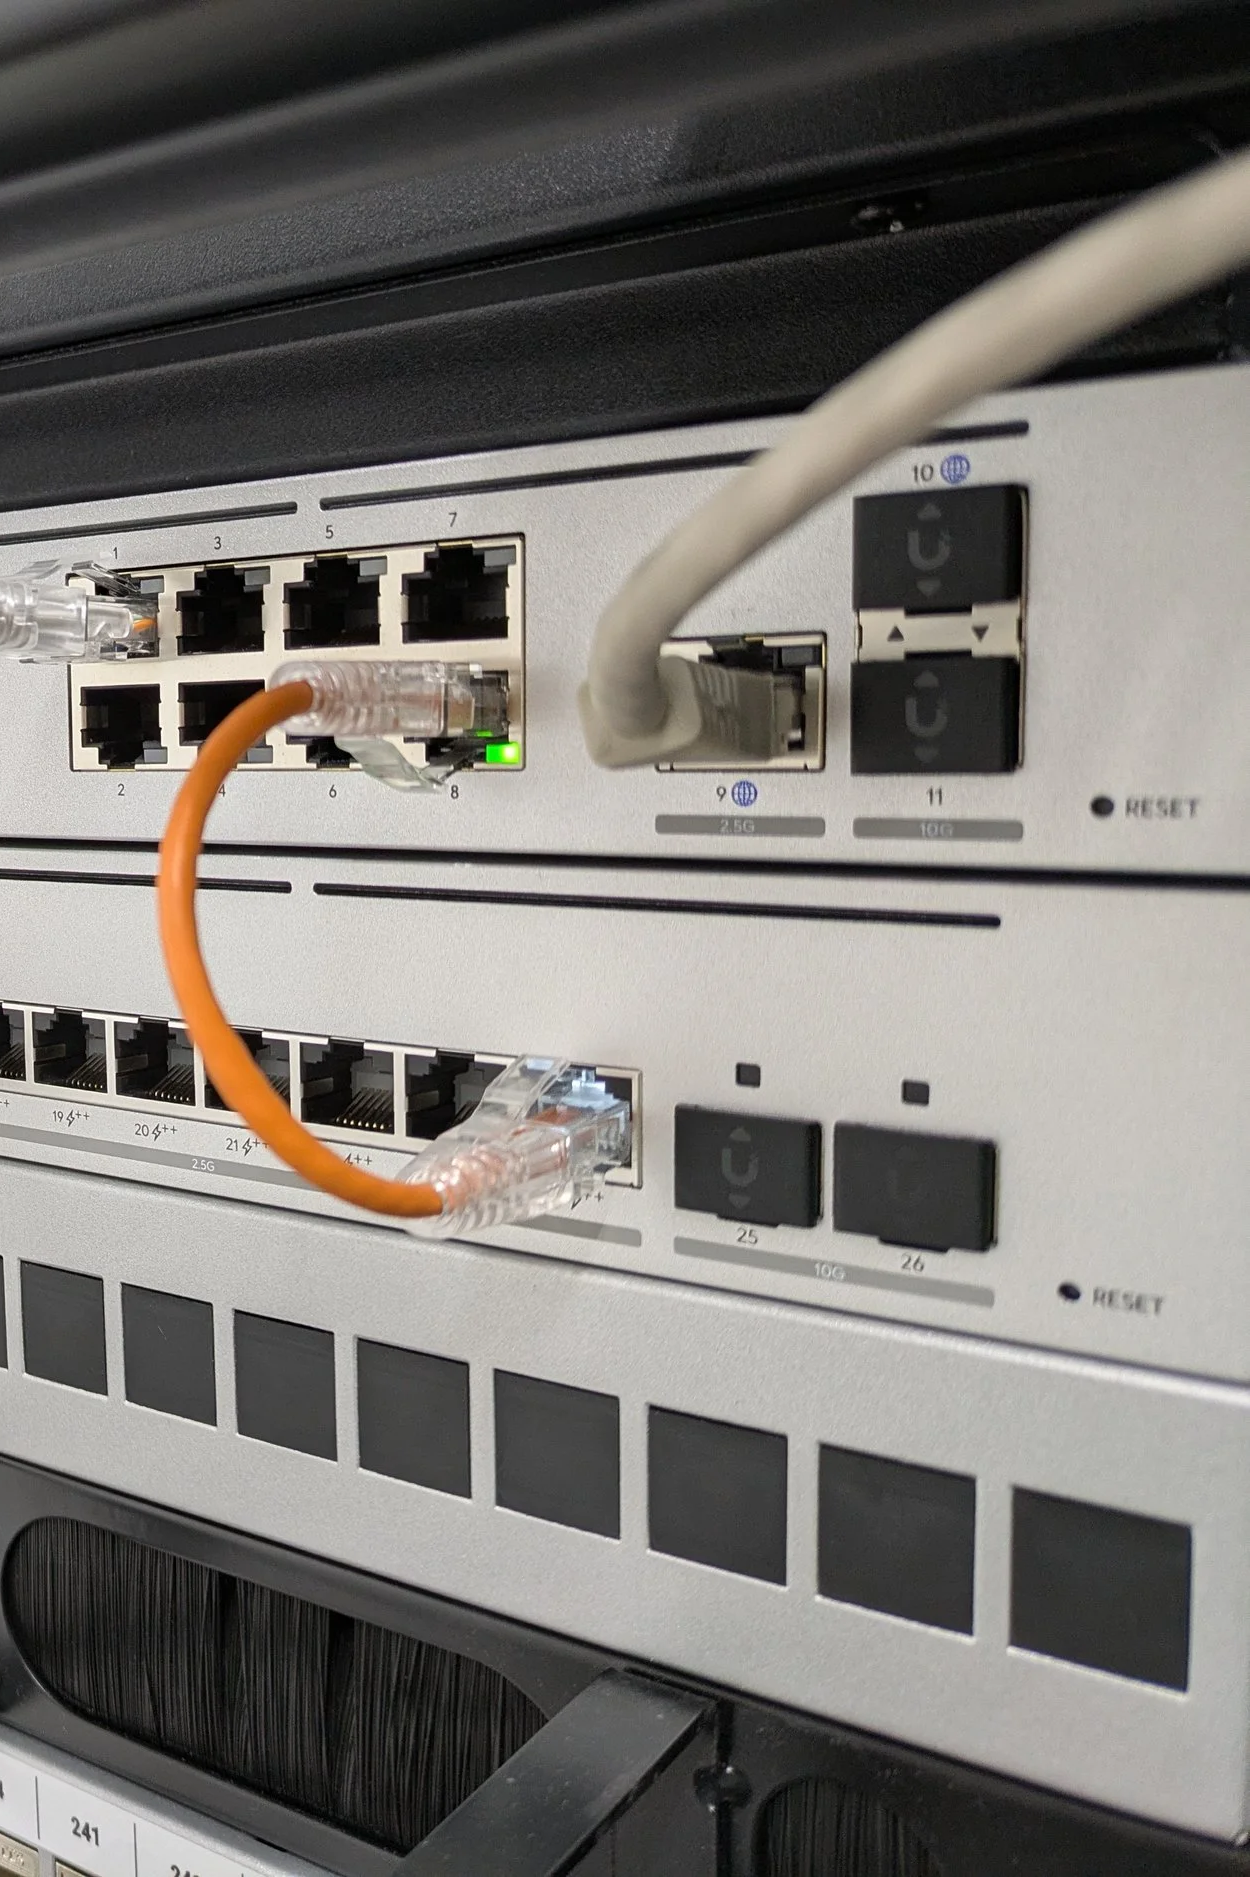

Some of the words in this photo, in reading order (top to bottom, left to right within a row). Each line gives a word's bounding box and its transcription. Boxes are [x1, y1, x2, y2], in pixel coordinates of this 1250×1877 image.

[912, 463, 934, 482] 10
[448, 511, 458, 528] 7
[325, 524, 334, 540] 5
[213, 535, 222, 550] 3
[112, 546, 118, 560] 1
[117, 783, 125, 797] 2
[218, 783, 226, 798] 4
[328, 783, 337, 799] 6
[450, 784, 460, 800] 8
[716, 785, 727, 802] 9
[926, 785, 944, 806] 11
[1124, 796, 1199, 819] RESET
[719, 818, 756, 835] 2.5G
[918, 821, 955, 839] 10G
[191, 1158, 216, 1172] 2.5G
[736, 1226, 759, 1246] 25
[900, 1251, 926, 1273] 26
[813, 1262, 847, 1282] 10G
[1092, 1286, 1164, 1317] RESET
[70, 1815, 100, 1847] 241
